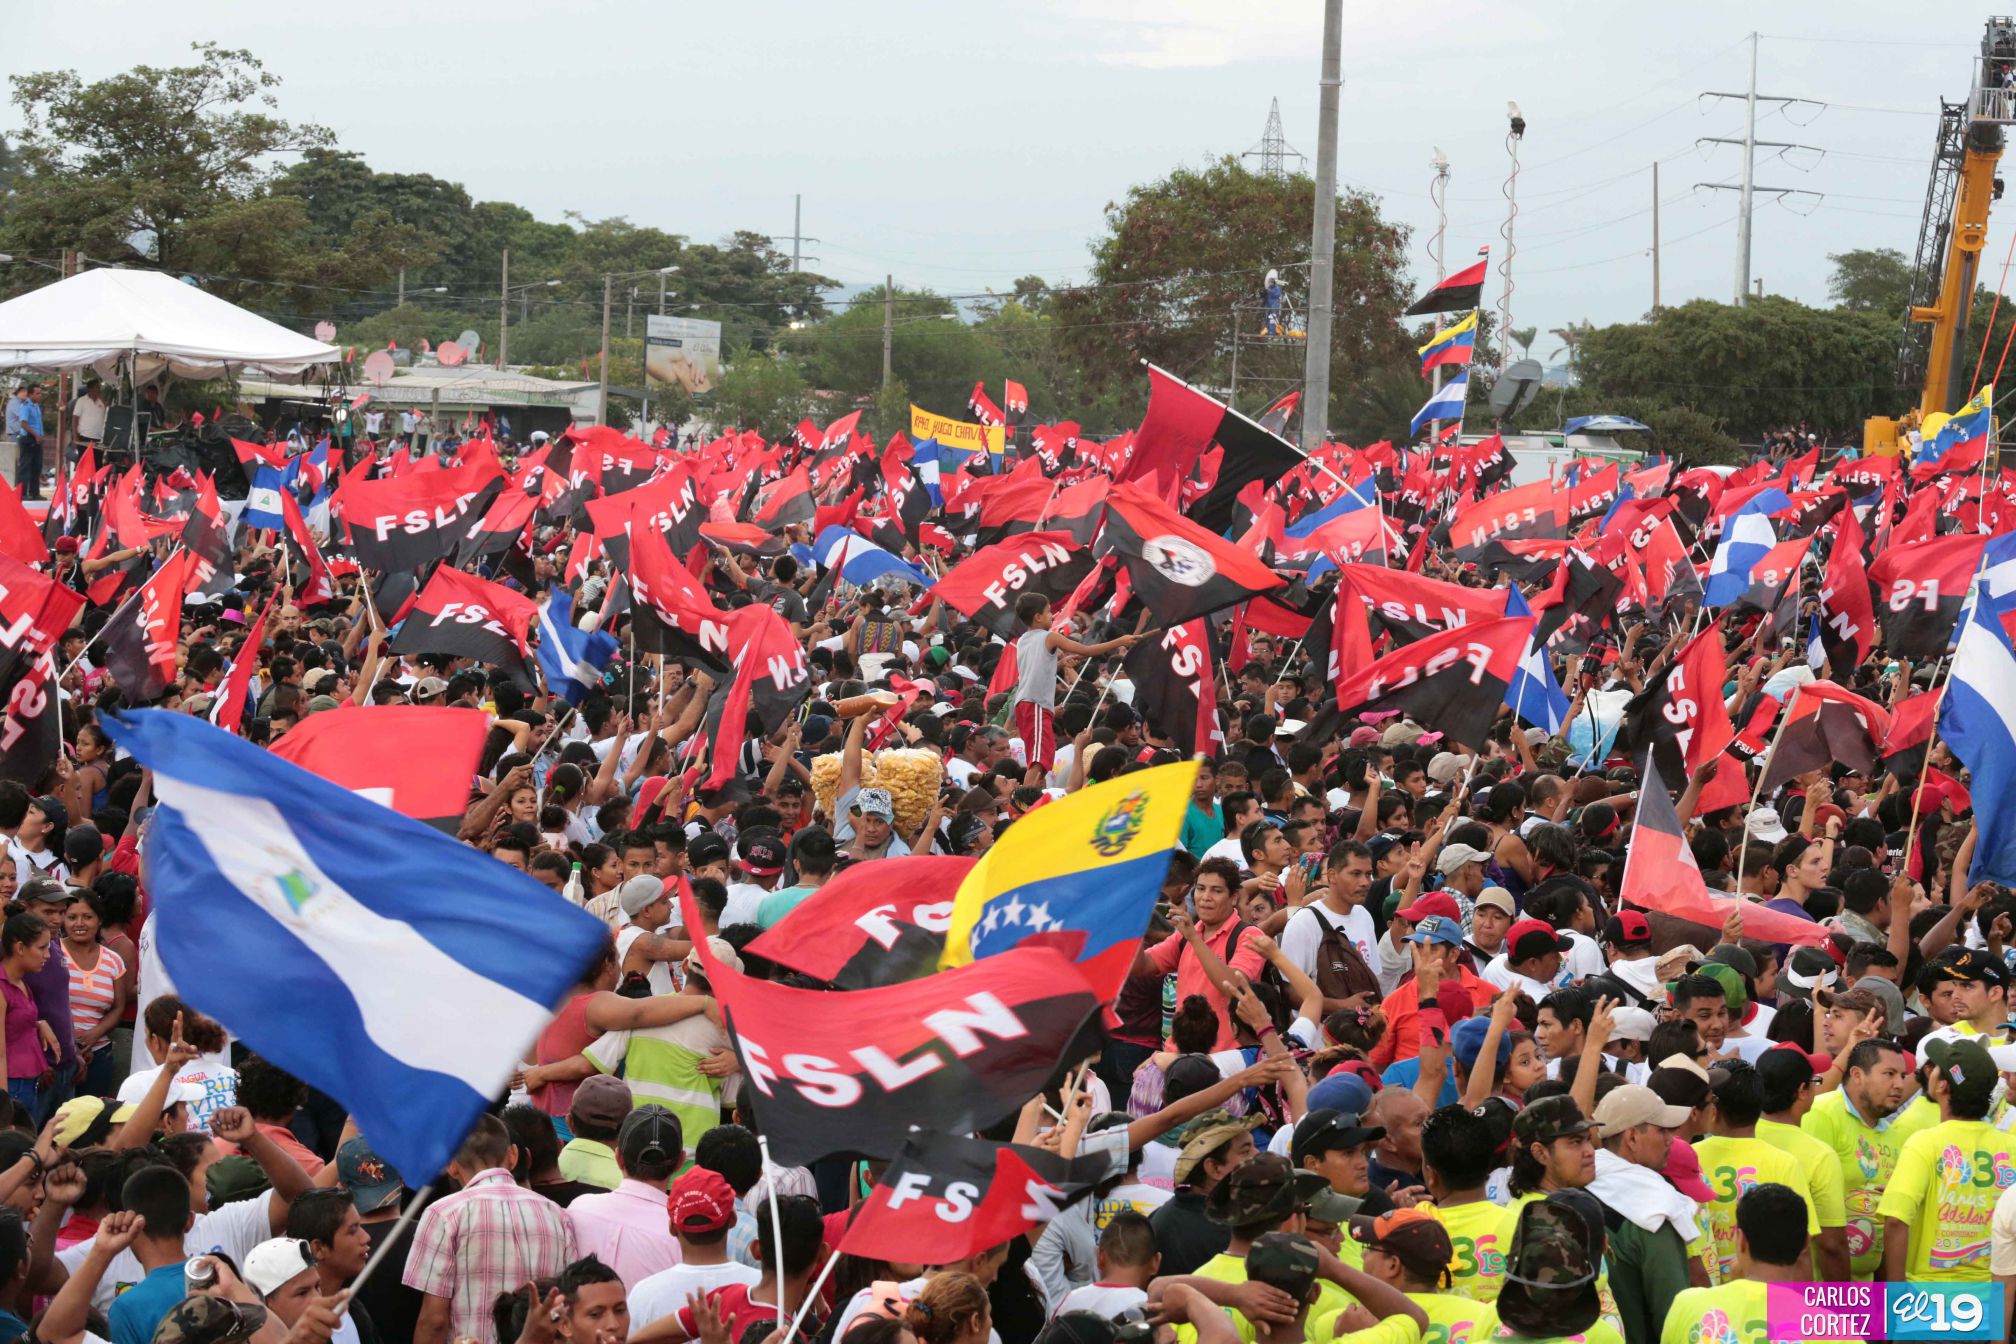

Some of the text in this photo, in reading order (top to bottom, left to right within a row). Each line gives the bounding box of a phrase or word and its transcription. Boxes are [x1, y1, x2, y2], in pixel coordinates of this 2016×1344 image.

[1009, 399, 1026, 414] FS
[1474, 450, 1504, 478] SLN
[327, 553, 360, 566] FSN
[983, 542, 1071, 610] FSLN
[1734, 740, 1757, 756] FSLN
[736, 991, 1030, 1108] FSLN
